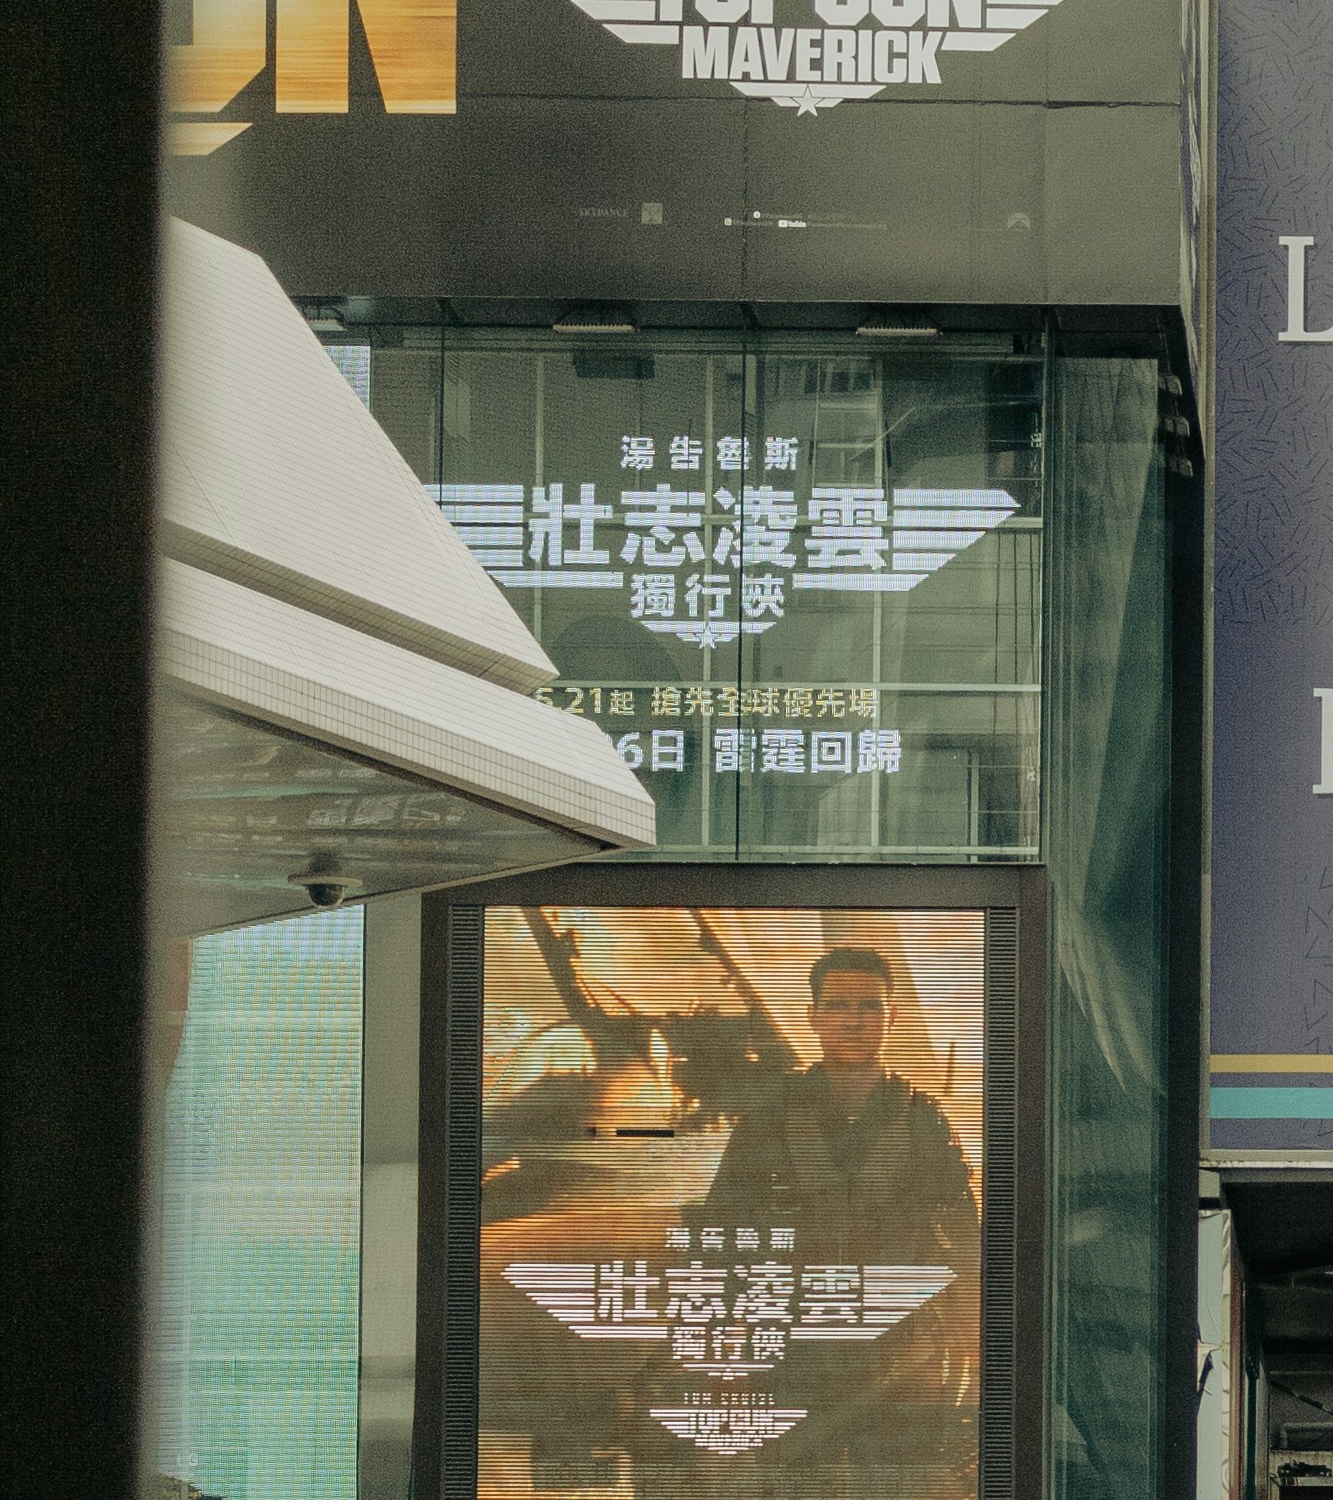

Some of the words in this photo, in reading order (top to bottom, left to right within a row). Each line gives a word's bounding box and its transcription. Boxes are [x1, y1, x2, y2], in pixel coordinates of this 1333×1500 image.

[680, 26, 943, 85] MAVERICK
[621, 435, 799, 471] 湯告魯斯
[528, 483, 889, 571] 壯志凌雲
[606, 729, 685, 773] 6日
[713, 728, 902, 774] 雷霆回歸
